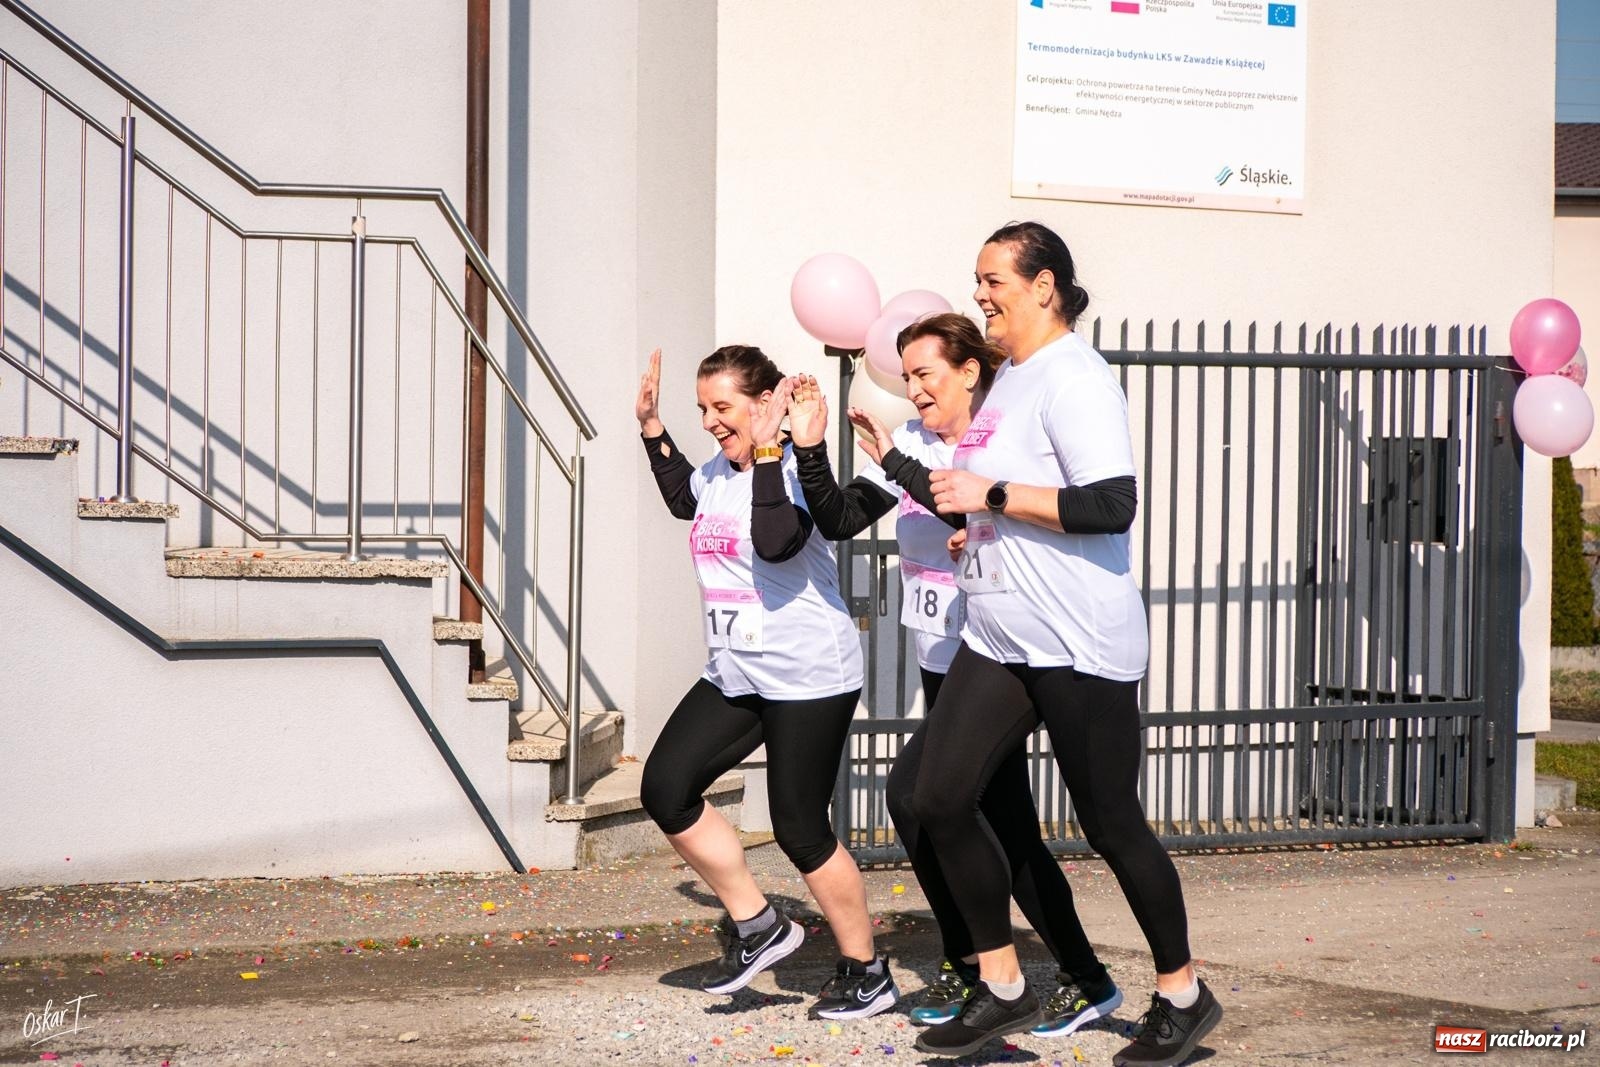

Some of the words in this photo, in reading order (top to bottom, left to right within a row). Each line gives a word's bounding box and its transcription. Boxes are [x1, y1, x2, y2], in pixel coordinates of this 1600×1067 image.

[1145, 5, 1167, 13] Polska
[1228, 0, 1262, 10] Europejska
[1028, 42, 1115, 58] Termomodernizacja
[1117, 48, 1154, 61] budynku
[1156, 52, 1173, 62] LKS
[1183, 54, 1223, 66] Zawadzie
[1225, 58, 1265, 71] Książęcej
[1026, 74, 1039, 83] Cel
[1040, 76, 1074, 86] projektu:
[1076, 78, 1107, 87] Ochrona
[1108, 81, 1144, 91] powietrza
[1155, 84, 1181, 93] terenie
[1182, 86, 1204, 97] Gminy
[1205, 87, 1227, 97] Nędza
[1228, 90, 1256, 100] poprzez
[1257, 92, 1298, 102] zwiększenie
[1025, 104, 1071, 114] Beneficjent:
[1075, 107, 1098, 116] Gmina
[1100, 108, 1122, 118] Nędza
[1076, 90, 1123, 101] efektywności
[1125, 94, 1175, 106] energetycznej
[1183, 98, 1213, 108] sektorze
[1214, 101, 1254, 111] publicznym
[1240, 164, 1293, 187] Śląskie.
[1123, 192, 1195, 203] www.mapadotacji.gov.pl
[697, 520, 725, 536] BIEG
[696, 537, 731, 553] KOBIET
[962, 548, 983, 580] 21
[914, 585, 939, 618] 18
[707, 608, 739, 636] 17
